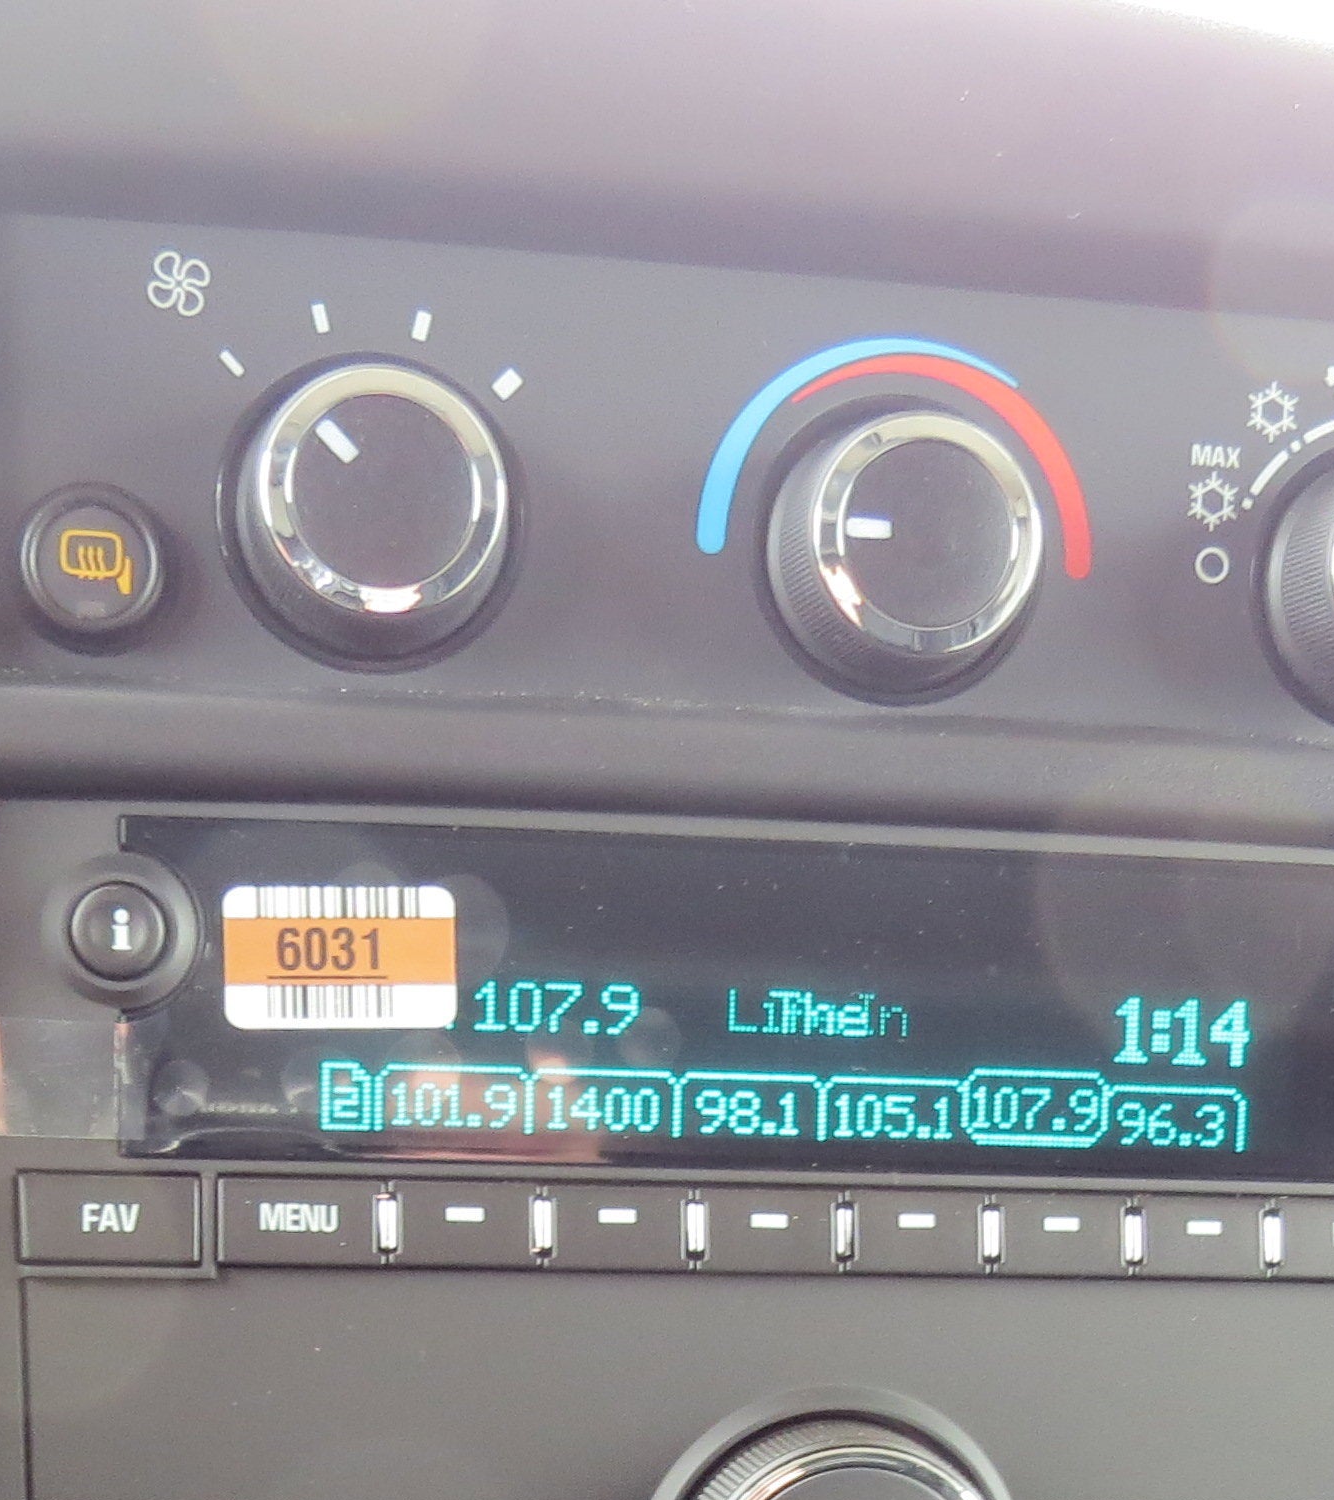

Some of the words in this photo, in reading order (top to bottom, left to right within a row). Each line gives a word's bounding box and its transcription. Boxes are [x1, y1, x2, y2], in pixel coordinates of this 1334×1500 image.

[1191, 443, 1242, 469] MAX
[276, 927, 382, 972] 6031
[474, 981, 641, 1034] 107.9
[1114, 997, 1252, 1068] 1:14
[390, 1081, 517, 1128] 101.9
[546, 1083, 661, 1132] 1400
[694, 1089, 799, 1137] 98.1
[834, 1094, 953, 1140] 105.1
[971, 1087, 1099, 1131] 107.9
[1114, 1101, 1225, 1148] 96.3
[82, 1203, 140, 1233] FAV
[259, 1203, 339, 1233] MENU
